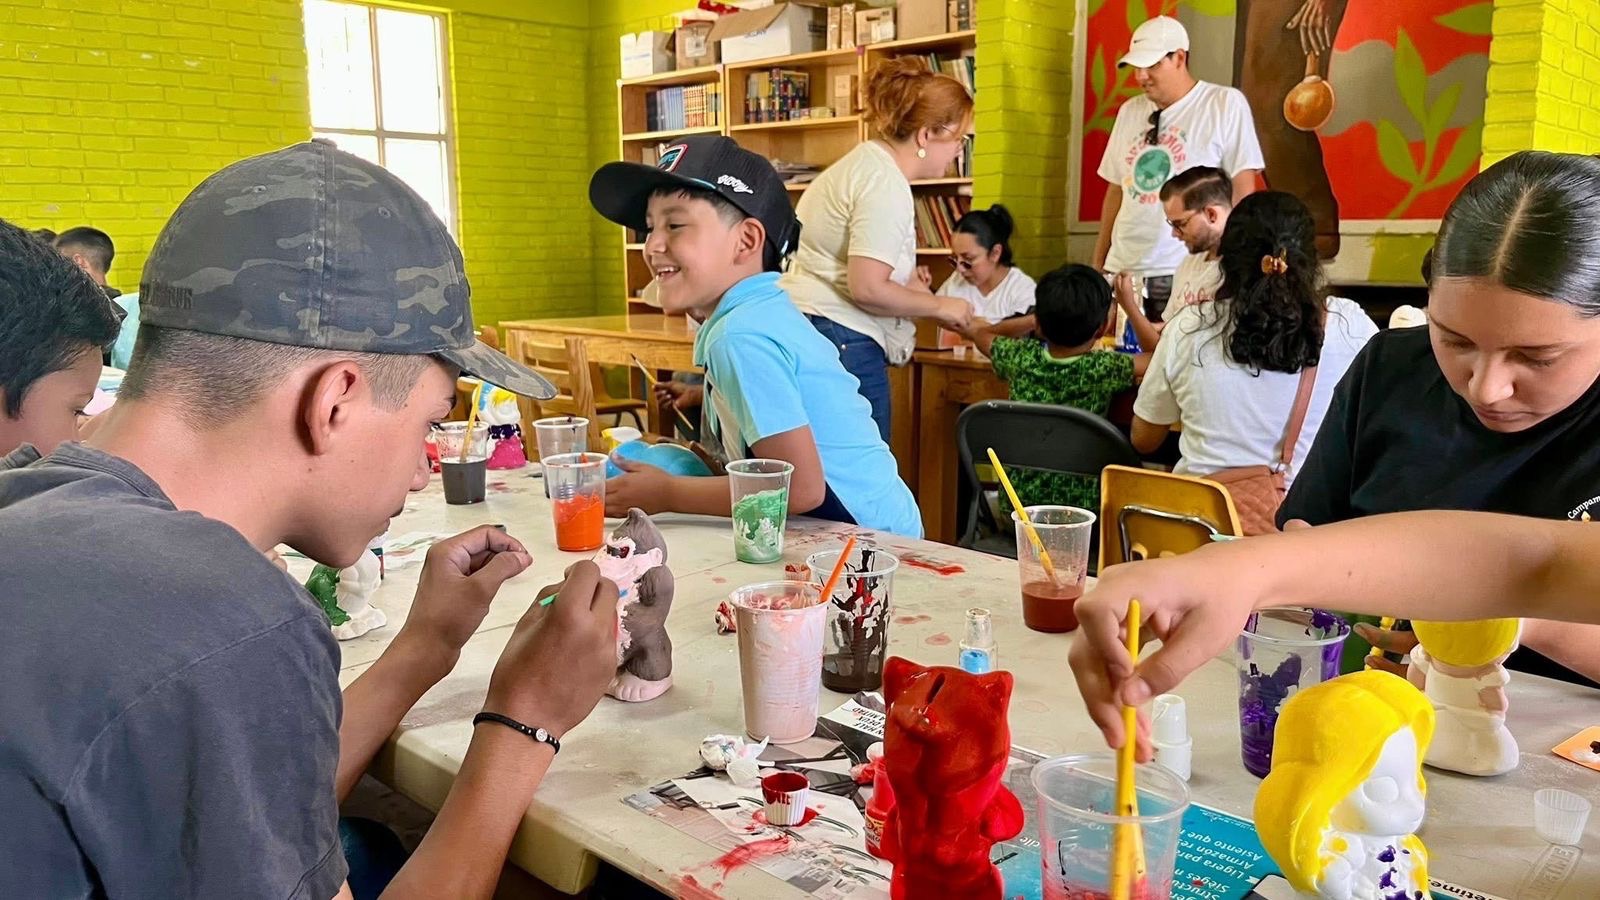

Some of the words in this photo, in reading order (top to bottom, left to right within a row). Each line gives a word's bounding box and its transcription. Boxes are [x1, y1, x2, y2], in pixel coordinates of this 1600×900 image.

[1567, 495, 1600, 519] Campam
[1186, 830, 1211, 843] que
[1196, 845, 1254, 870] Armazón
[1213, 839, 1263, 861] Asiento
[1203, 858, 1244, 878] Ligera
[1185, 871, 1230, 893] Sièges
[1427, 879, 1492, 900] etime.
